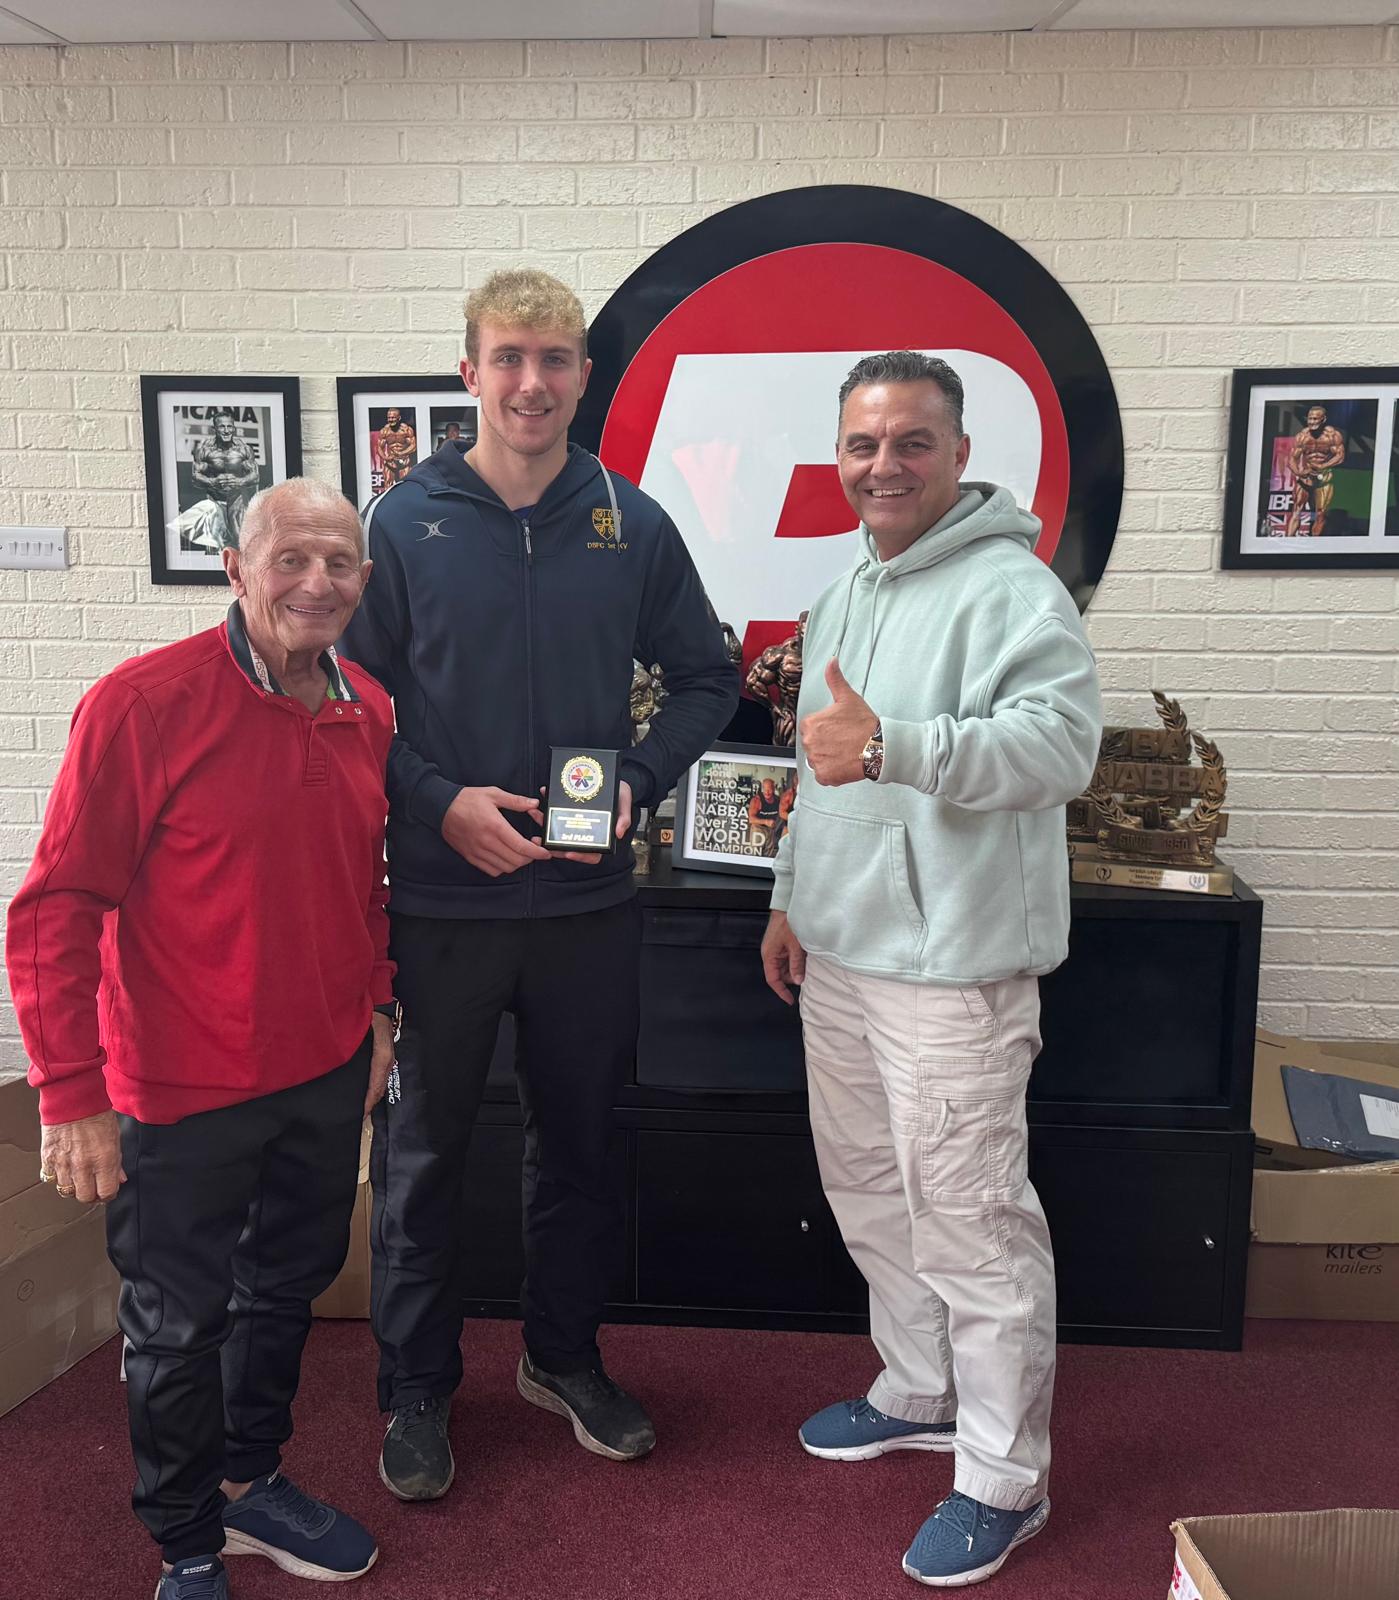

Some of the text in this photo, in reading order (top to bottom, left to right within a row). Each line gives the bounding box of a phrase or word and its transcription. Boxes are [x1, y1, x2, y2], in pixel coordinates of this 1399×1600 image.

[700, 778, 737, 789] CARLO
[1095, 765, 1220, 792] NABBA
[696, 803, 749, 818] NABBA
[695, 815, 748, 831] Over 55
[695, 827, 766, 846] WORLD
[696, 842, 763, 856] CHAMPION
[1326, 1244, 1384, 1260] kite
[1324, 1260, 1383, 1274] mailers
